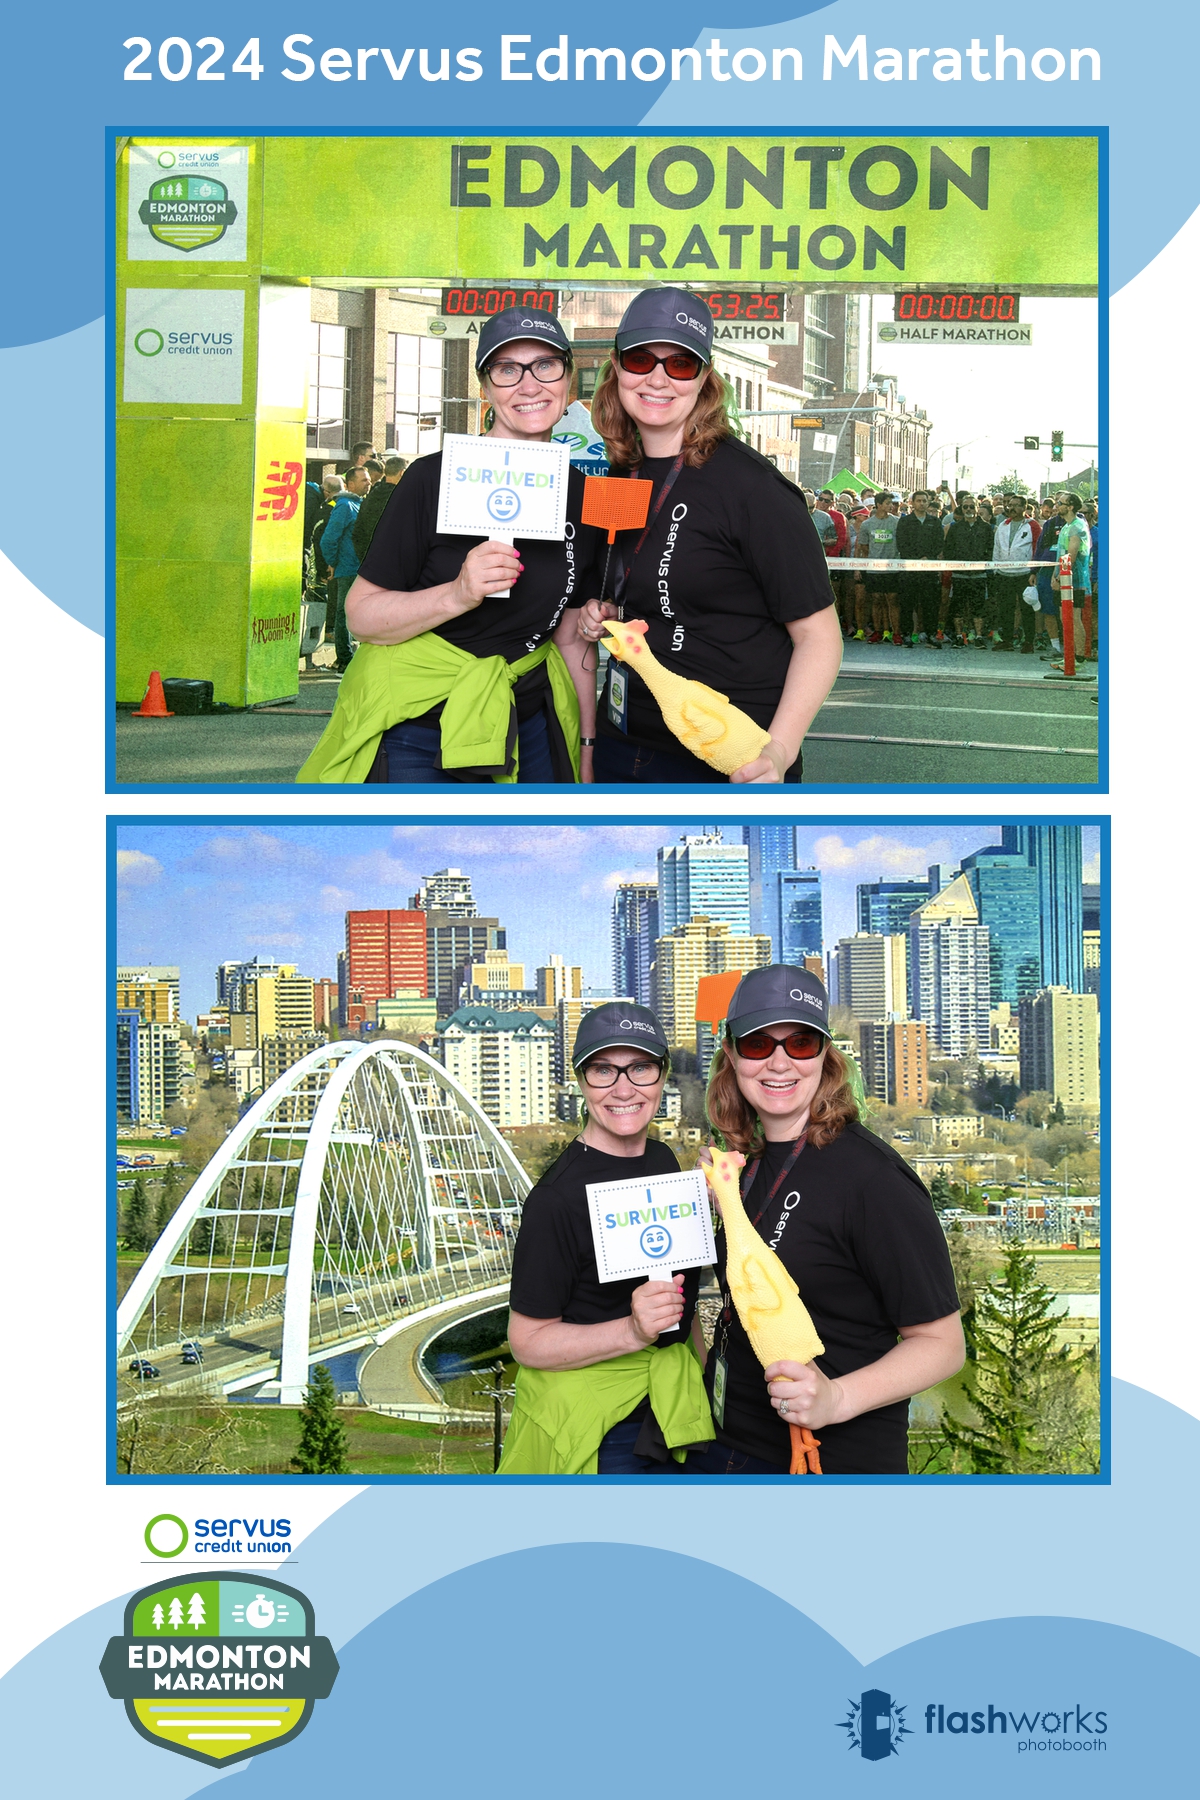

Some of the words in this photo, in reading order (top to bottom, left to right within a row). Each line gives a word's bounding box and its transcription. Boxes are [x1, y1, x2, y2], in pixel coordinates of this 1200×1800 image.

[178, 152, 220, 161] servus
[449, 144, 991, 211] EDMONTON
[149, 202, 227, 214] EDMONTON
[160, 214, 215, 222] MARATHON
[522, 223, 907, 272] MARATHON
[168, 331, 233, 345] servus
[900, 328, 939, 340] HALF
[942, 328, 1031, 341] MARATHON
[167, 345, 200, 355] credit
[203, 347, 233, 356] union
[504, 451, 510, 466] I
[455, 466, 554, 489] SURVIVED!
[658, 522, 680, 577] servus
[565, 541, 576, 595] servus
[657, 580, 675, 619] cred
[646, 1188, 653, 1204] I
[605, 1201, 698, 1229] SURVIVED!
[768, 1211, 790, 1251] serv
